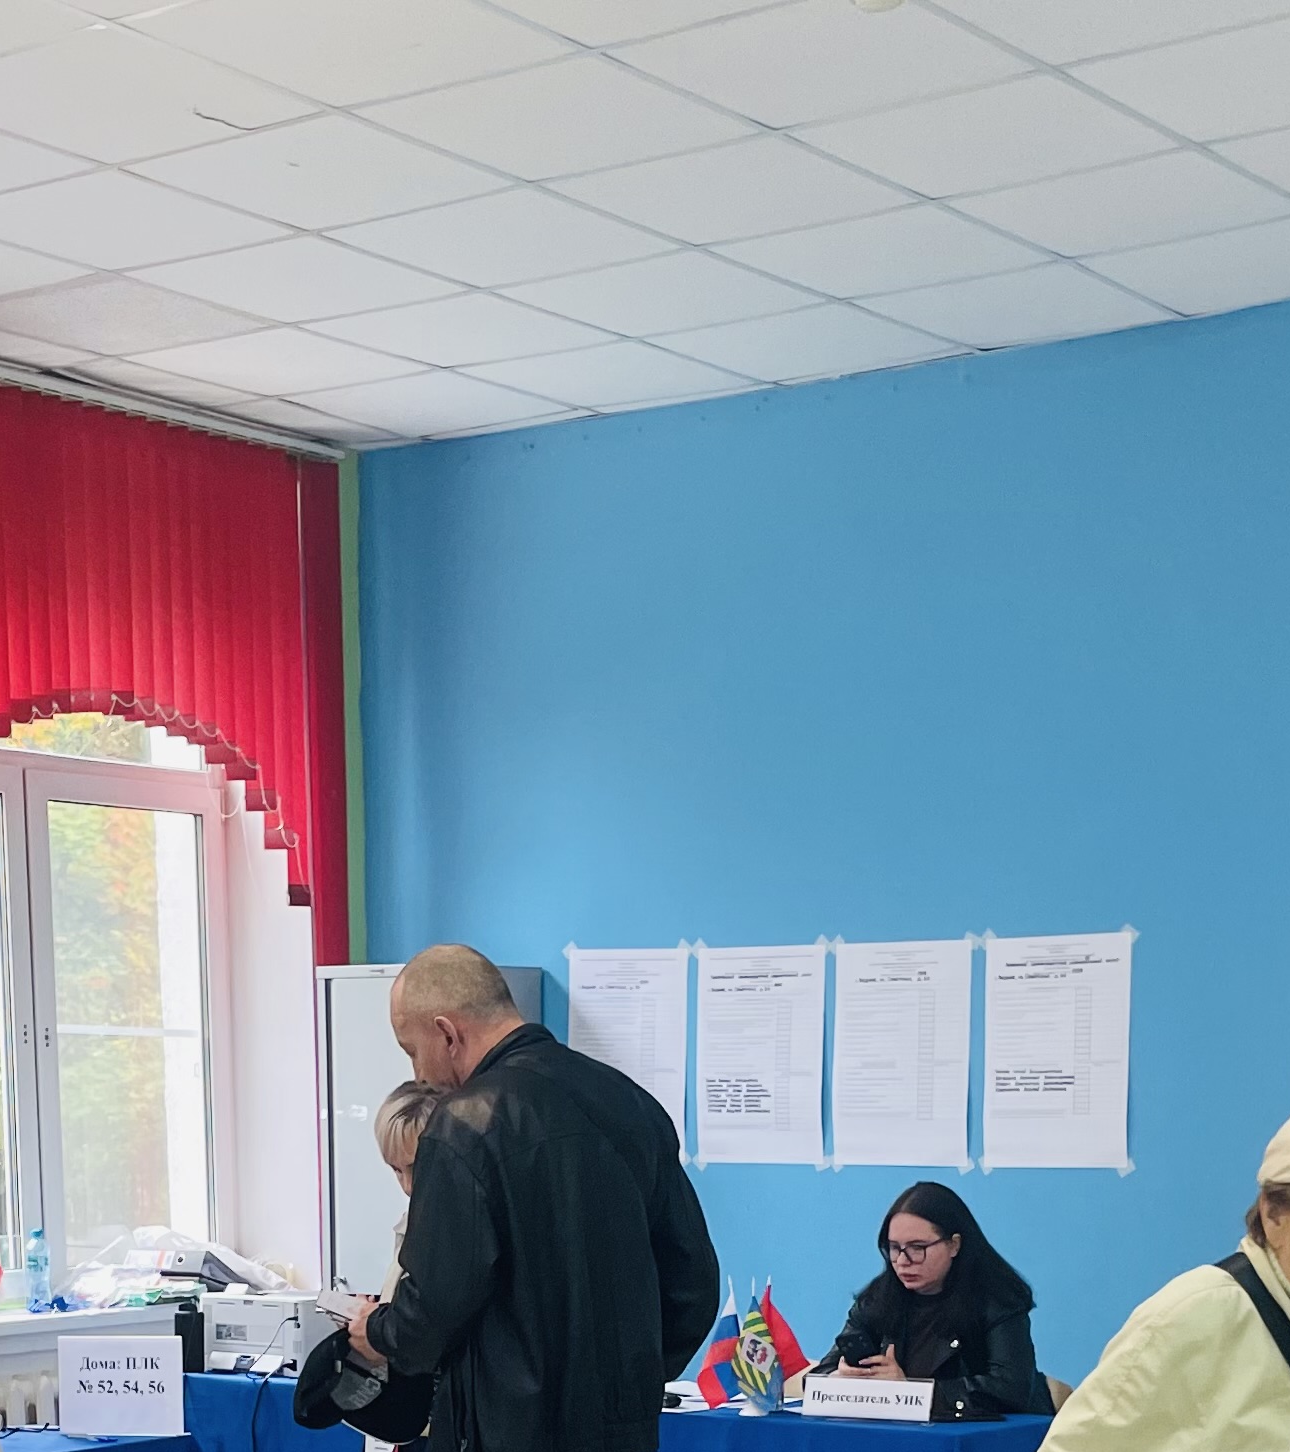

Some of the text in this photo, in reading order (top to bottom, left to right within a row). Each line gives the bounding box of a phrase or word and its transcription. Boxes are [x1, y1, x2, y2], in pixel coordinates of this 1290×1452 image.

[79, 1356, 160, 1372] Дома: ПЛК
[76, 1379, 165, 1396] № 52, 54, 56
[811, 1390, 925, 1407] Председатель УИК
